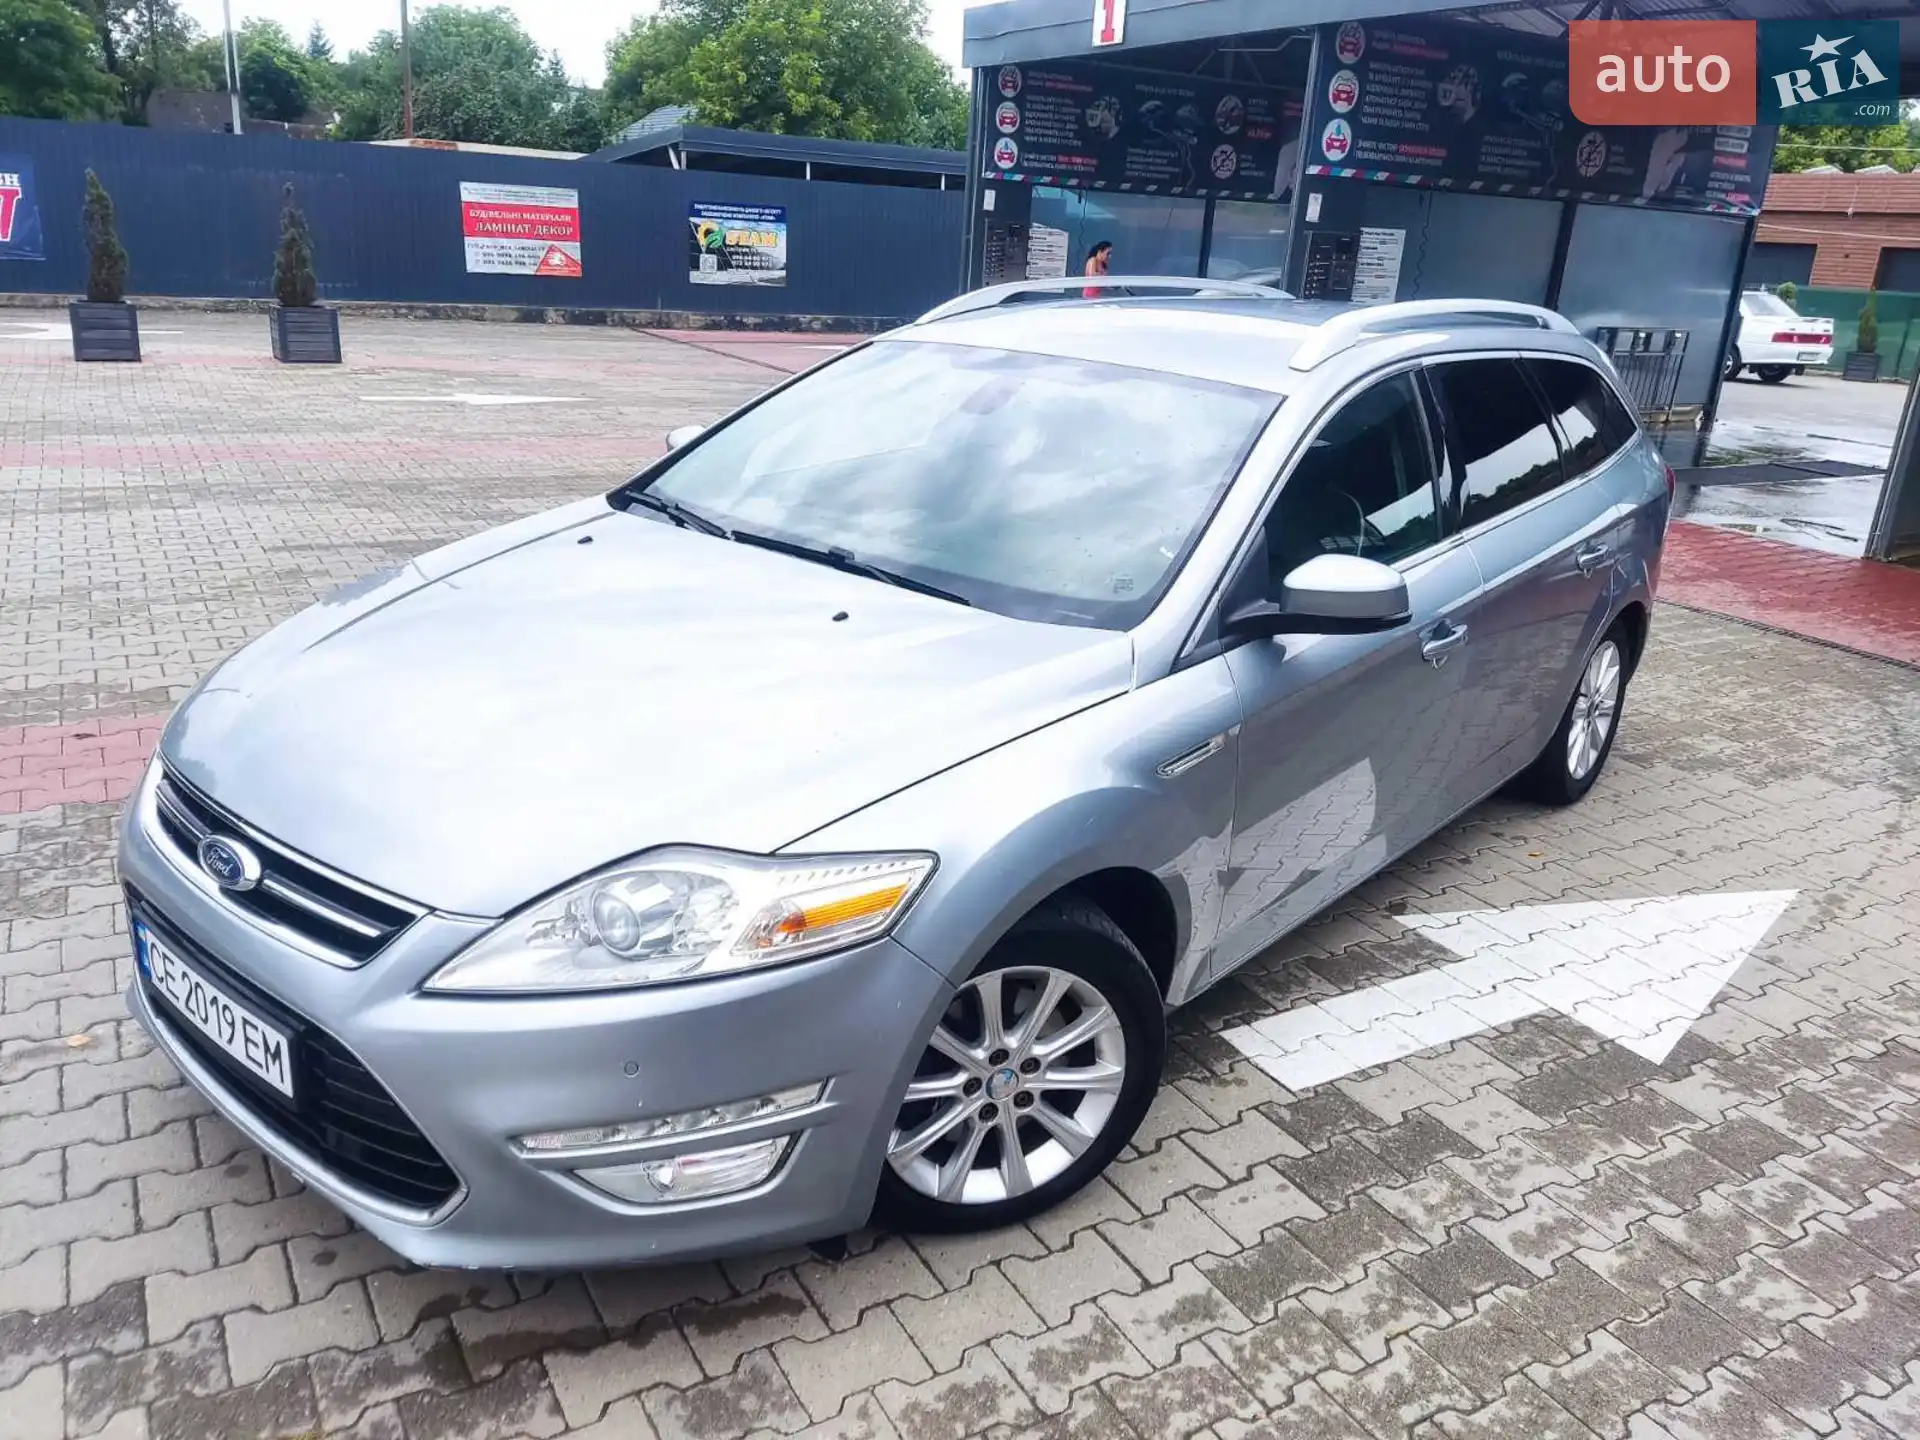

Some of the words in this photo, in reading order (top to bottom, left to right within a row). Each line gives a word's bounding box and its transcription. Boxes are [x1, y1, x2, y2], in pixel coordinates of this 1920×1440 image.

[1100, 0, 1115, 43] 1
[474, 222, 532, 234] ЛАМІНАТ
[533, 225, 574, 237] ДЕКОР
[206, 847, 234, 876] Ford
[150, 941, 180, 1001] CE
[181, 970, 236, 1046] 2019
[241, 1014, 285, 1085] EM
